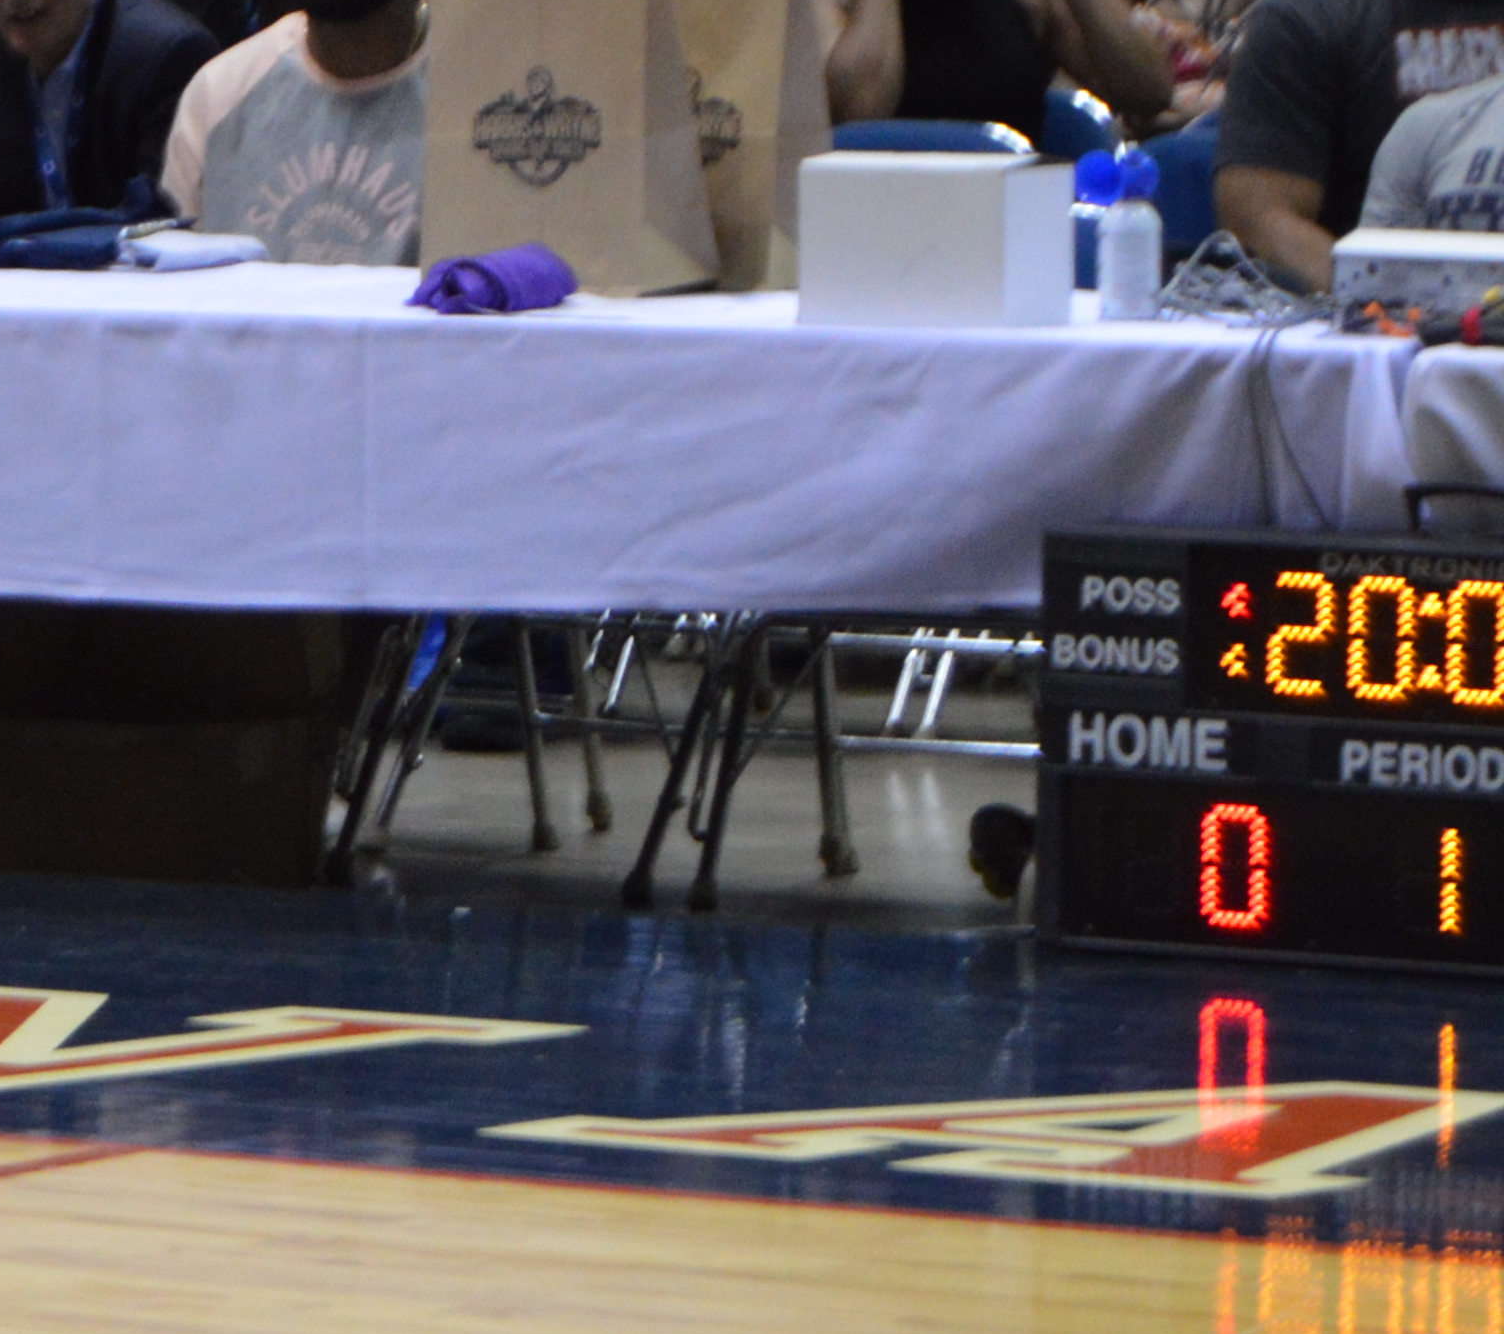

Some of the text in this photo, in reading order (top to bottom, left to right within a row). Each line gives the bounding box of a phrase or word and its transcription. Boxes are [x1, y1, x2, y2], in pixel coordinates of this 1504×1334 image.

[1319, 551, 1504, 582] DAKTRONI
[1080, 574, 1182, 616] POSS
[1051, 633, 1180, 673] BONUS
[1067, 710, 1230, 775] HOME
[1339, 738, 1504, 794] PERIOD
[1200, 803, 1270, 930] 0
[1438, 827, 1463, 935] 1
